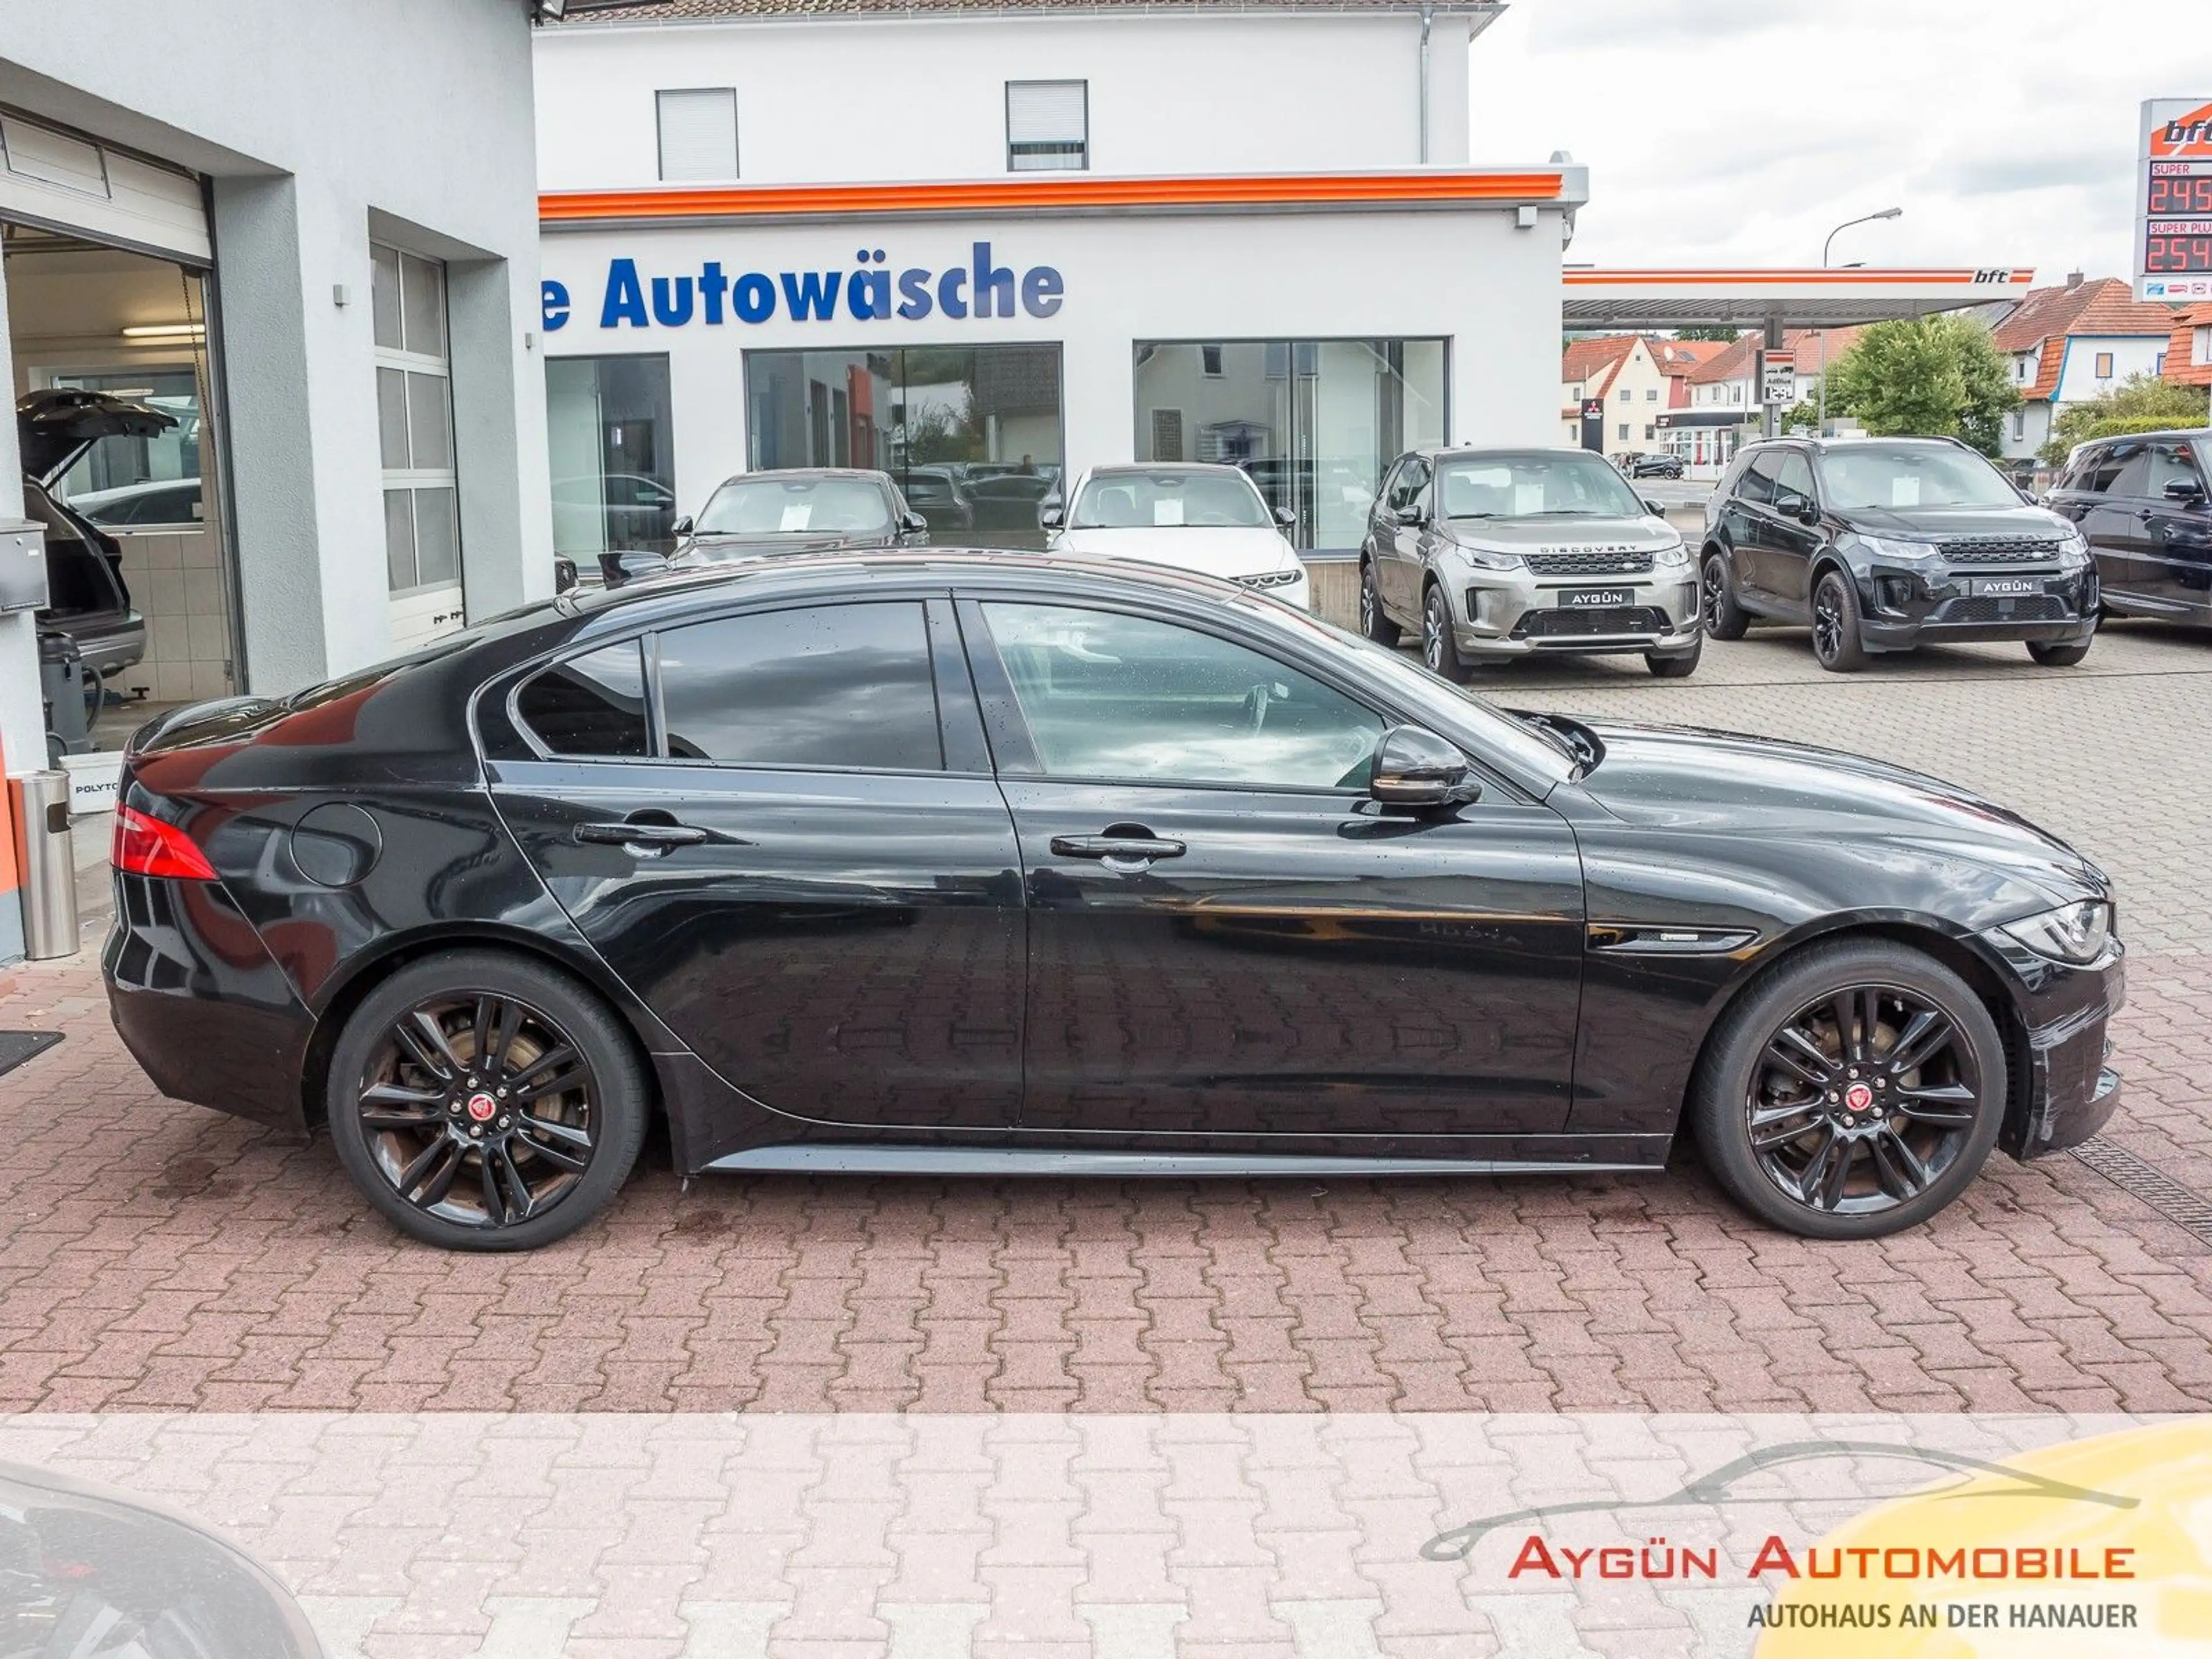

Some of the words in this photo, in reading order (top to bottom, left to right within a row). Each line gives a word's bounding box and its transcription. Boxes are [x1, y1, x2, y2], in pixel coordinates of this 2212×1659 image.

[2154, 164, 2190, 175] SUPER
[2151, 223, 2187, 233] SUPER
[2148, 238, 2210, 270] 254
[1974, 270, 2008, 283] bft
[541, 281, 570, 331] e
[600, 241, 1065, 328] Autowäsche
[1984, 580, 2032, 592] AYGÜN
[1572, 592, 1623, 604] AYGÜN
